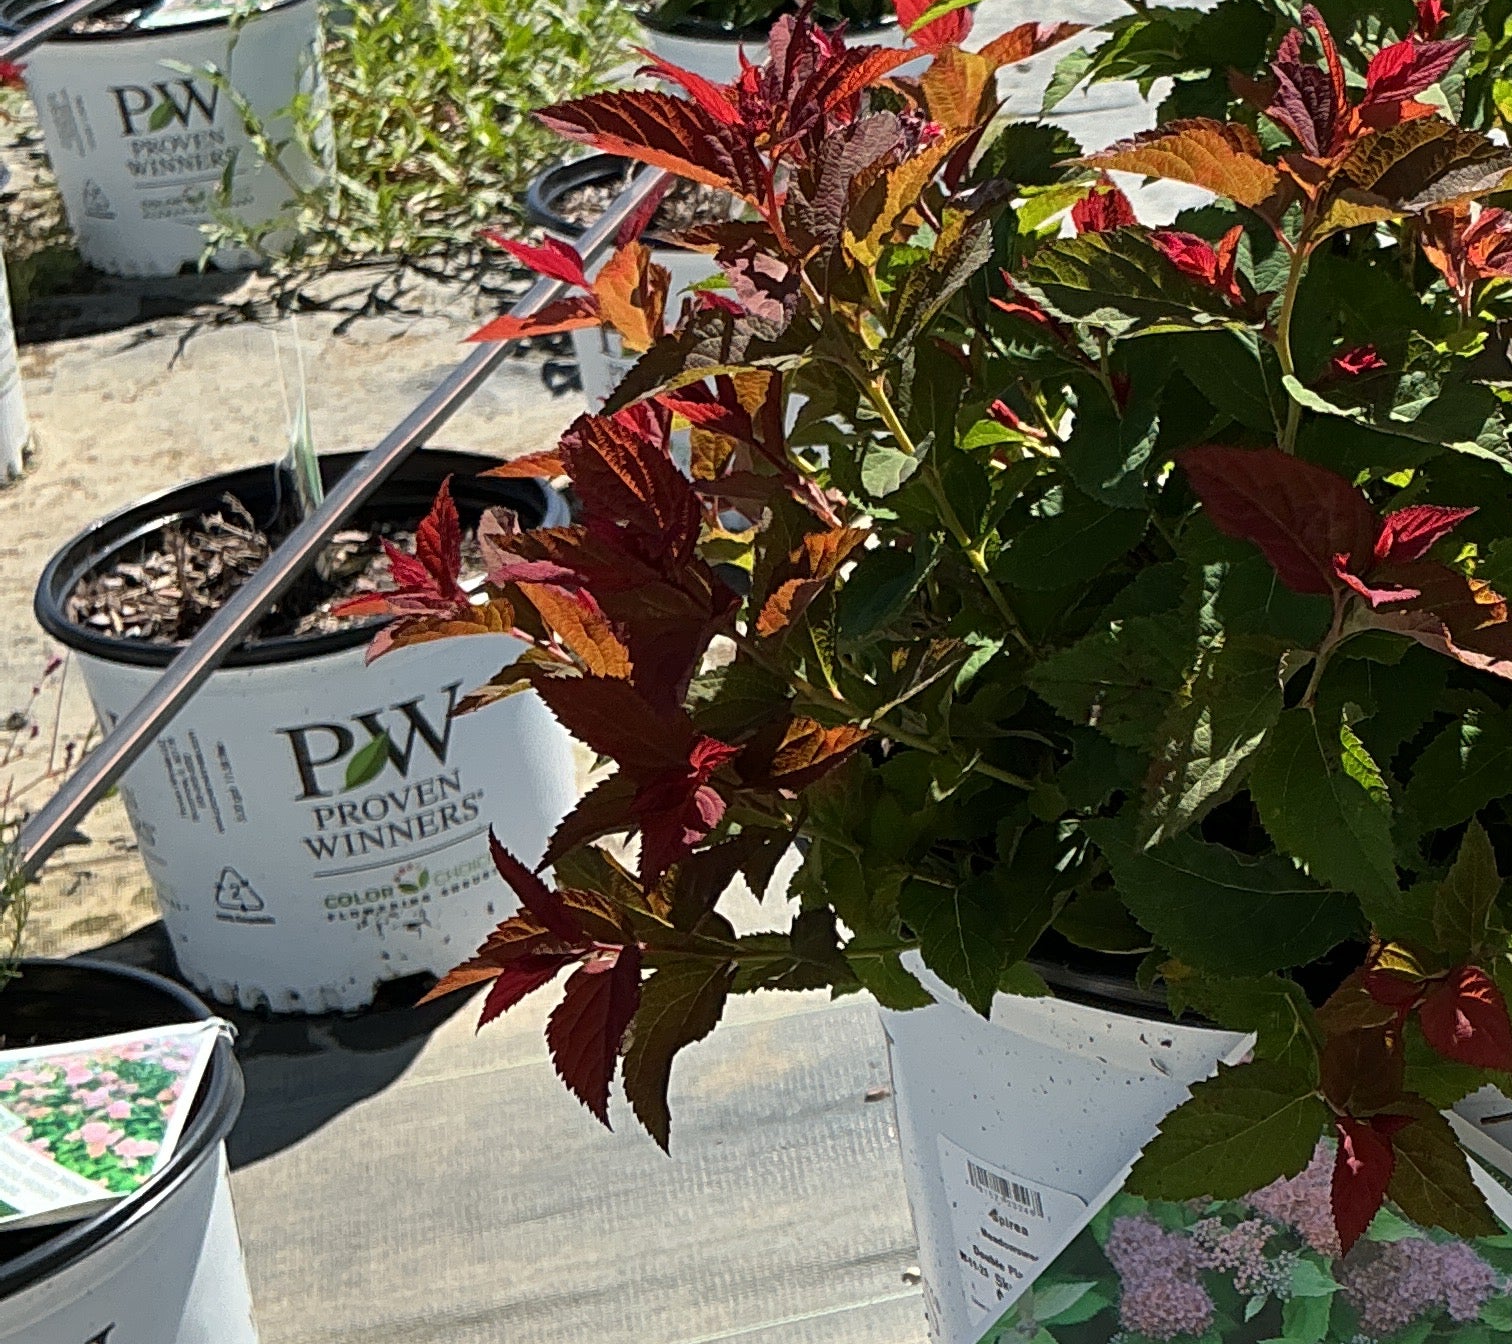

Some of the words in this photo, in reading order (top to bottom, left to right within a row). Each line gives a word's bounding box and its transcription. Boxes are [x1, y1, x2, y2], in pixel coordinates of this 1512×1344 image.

[106, 78, 221, 138] PW
[275, 679, 465, 802] PW
[302, 789, 484, 861] WINNERS
[312, 767, 463, 832] PROVEN
[323, 885, 395, 909] COLOR
